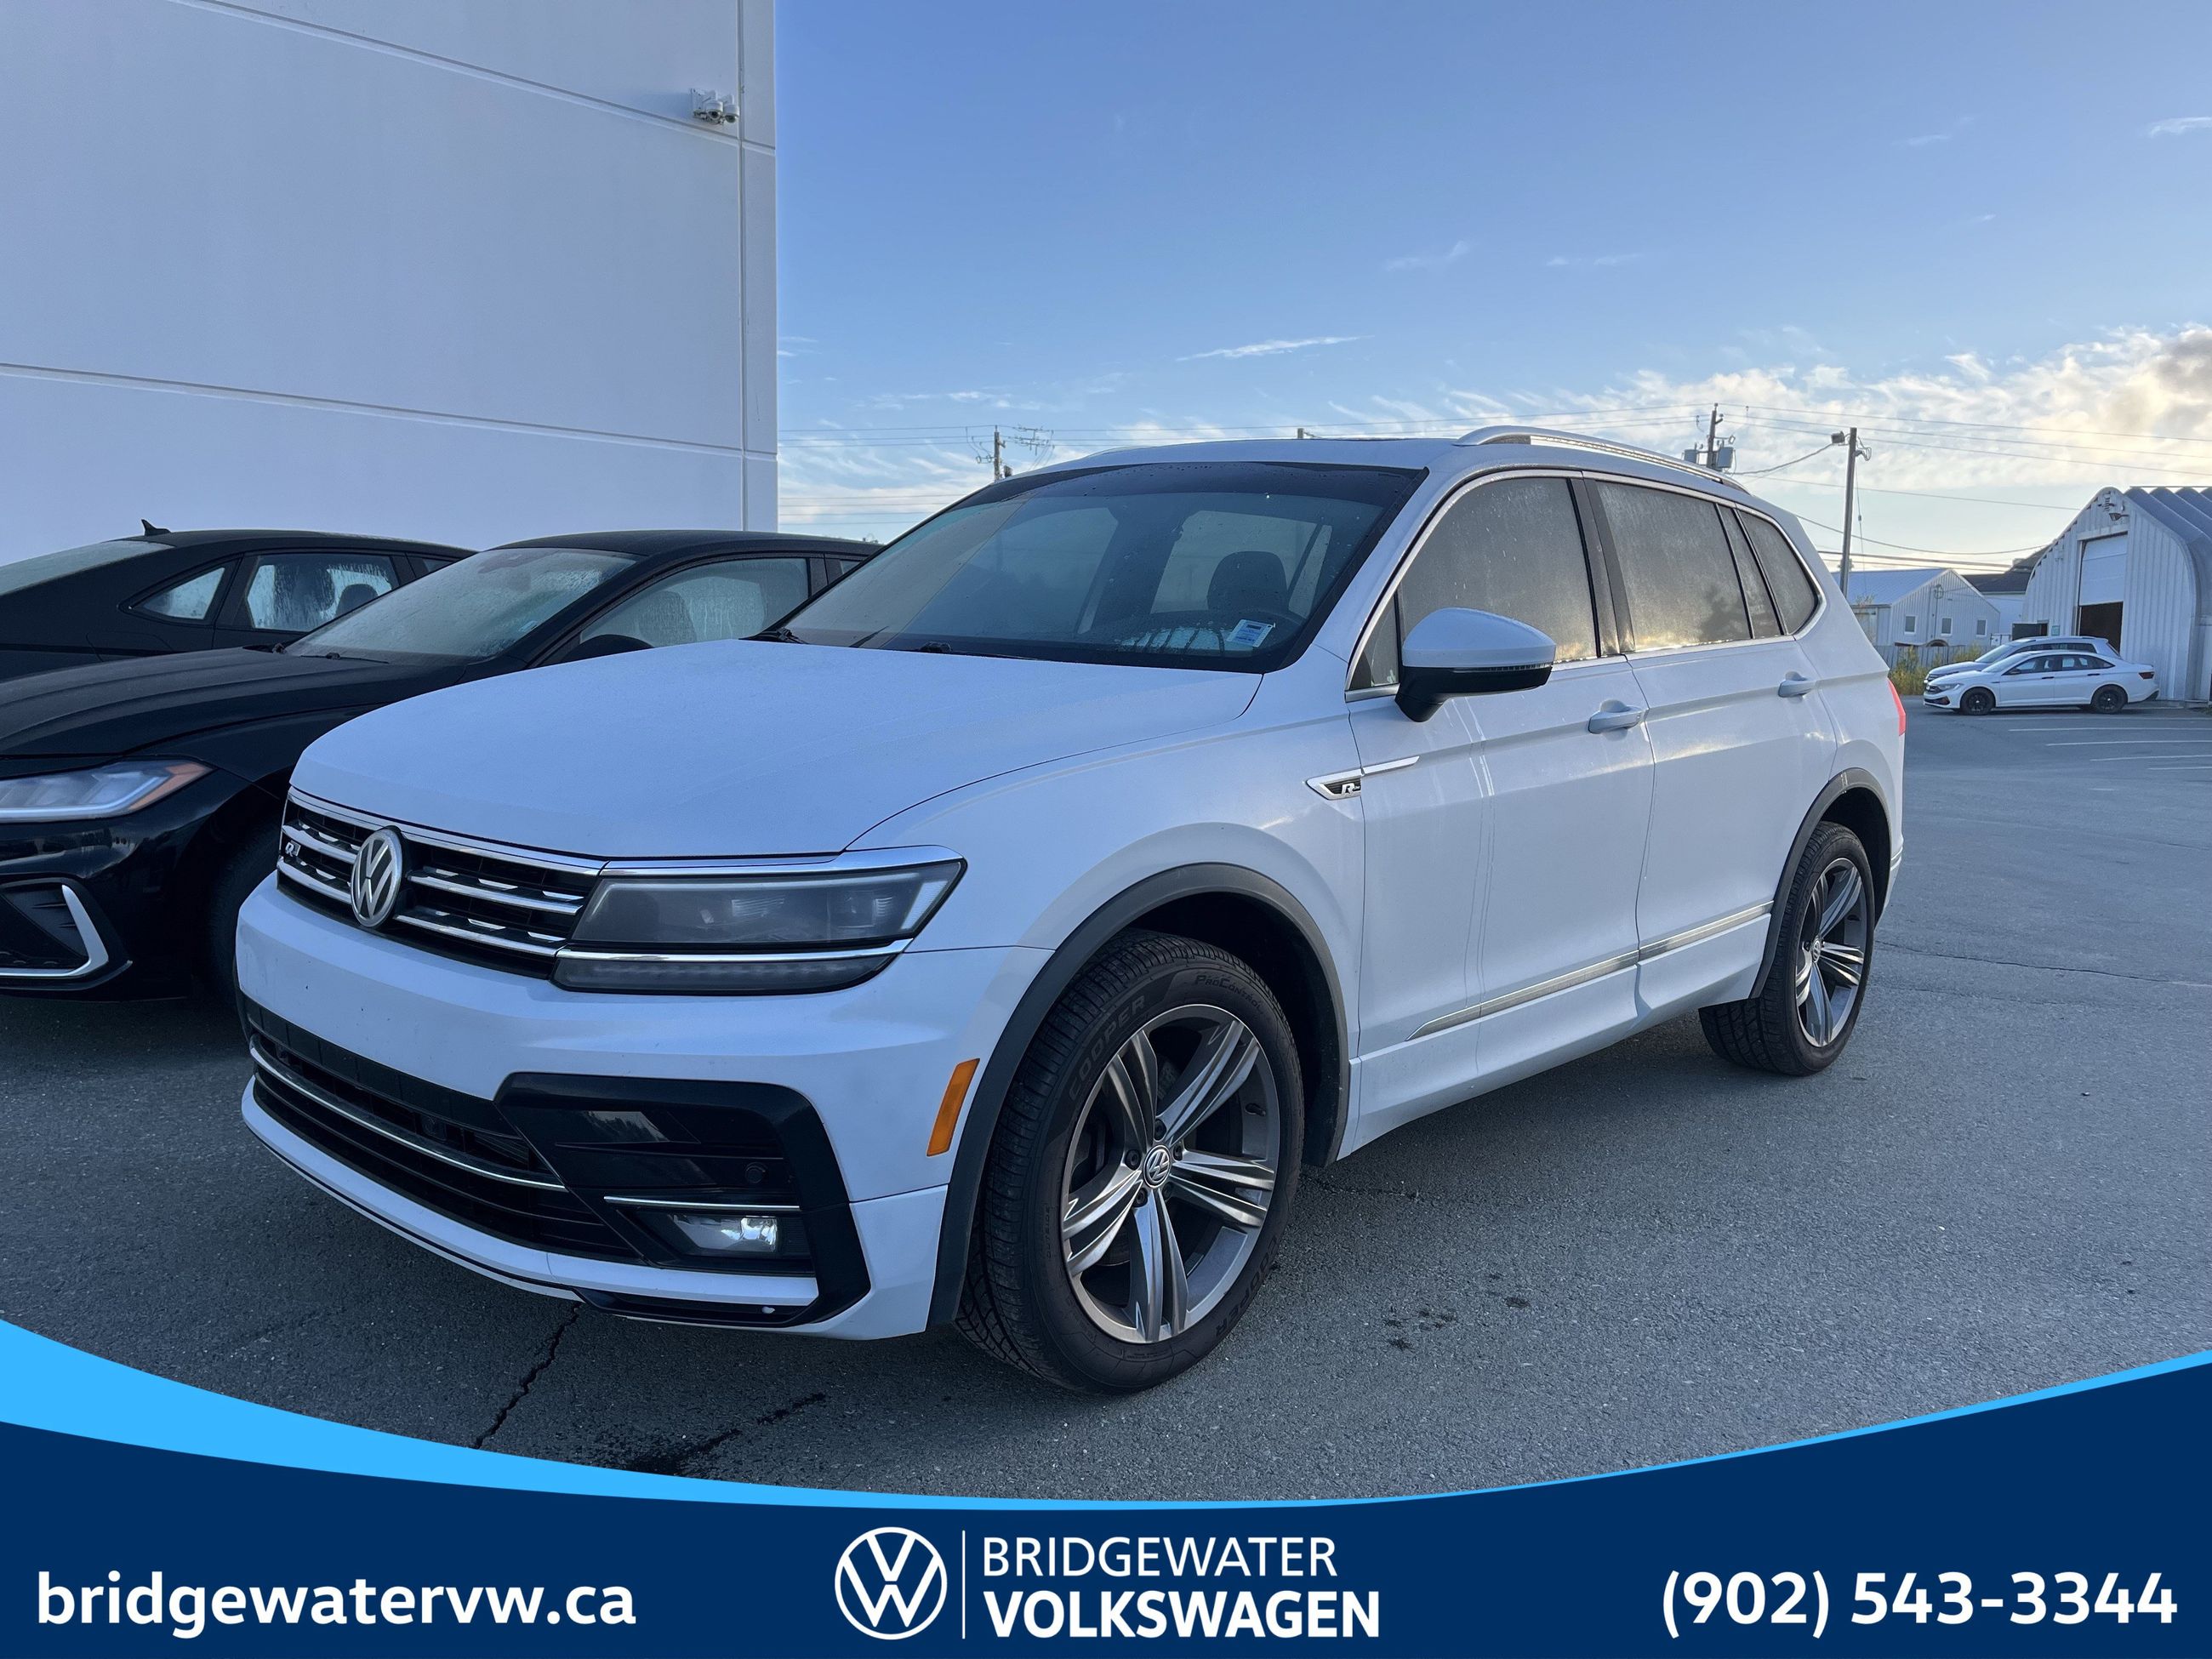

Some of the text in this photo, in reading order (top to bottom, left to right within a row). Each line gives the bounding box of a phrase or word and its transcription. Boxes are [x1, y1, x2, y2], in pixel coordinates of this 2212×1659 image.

[351, 829, 402, 927] VW
[1069, 995, 1145, 1101] COOPER
[1143, 1146, 1172, 1188] VW
